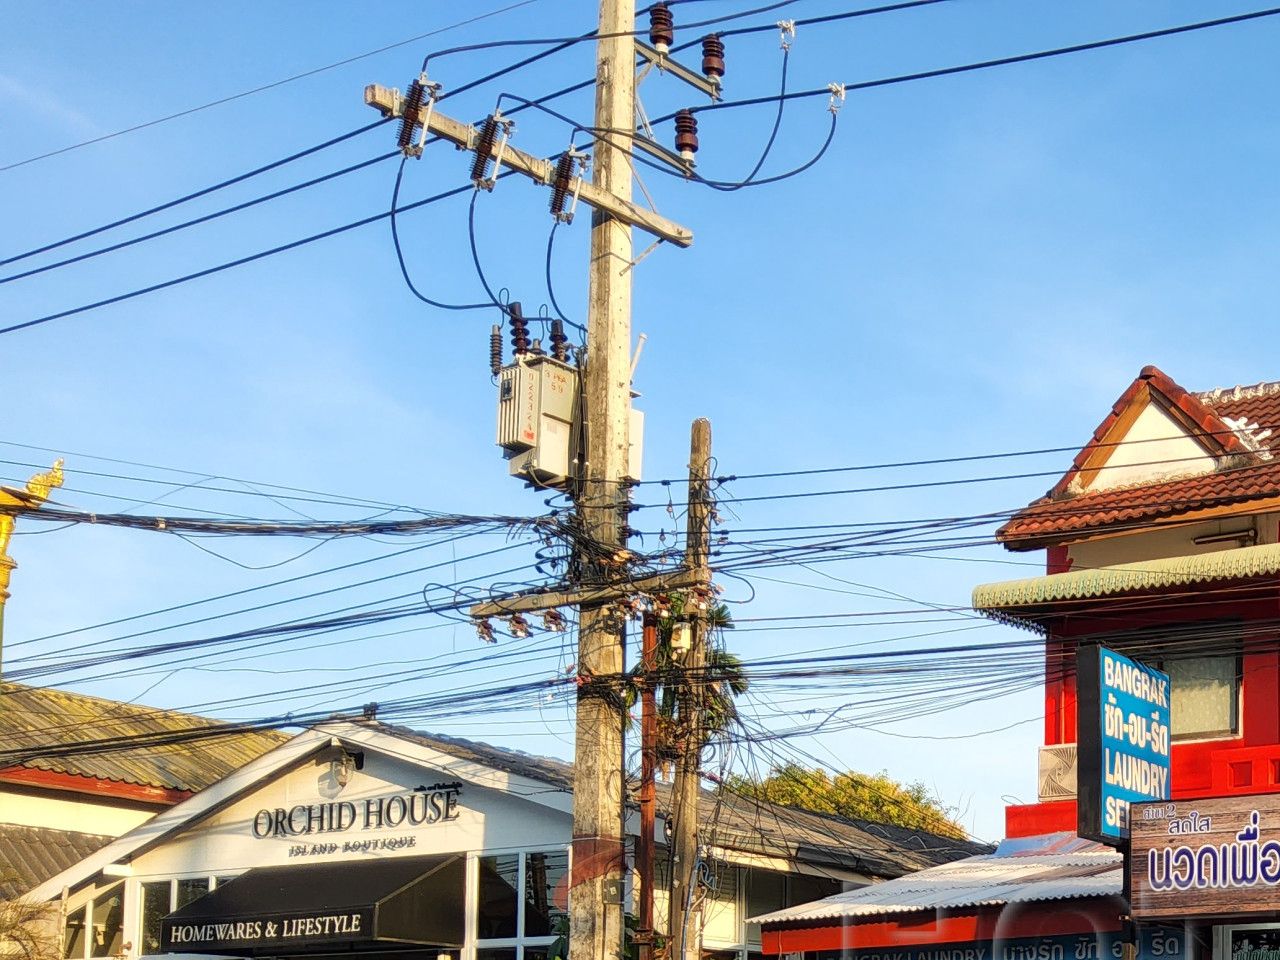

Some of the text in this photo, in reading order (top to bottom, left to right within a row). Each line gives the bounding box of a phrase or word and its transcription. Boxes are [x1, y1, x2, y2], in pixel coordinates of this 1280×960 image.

[1104, 656, 1167, 708] BANGRAK
[1105, 748, 1168, 800] LAUNDRY
[252, 790, 461, 839] ORCHID HOUSE
[1166, 802, 1176, 818] 2
[1168, 809, 1211, 834] สดใส
[289, 836, 416, 857] ISLAND BOUTIQUE
[170, 914, 361, 942] HOMEWARES & LIFESTYLE
[1151, 930, 1179, 956] รีด
